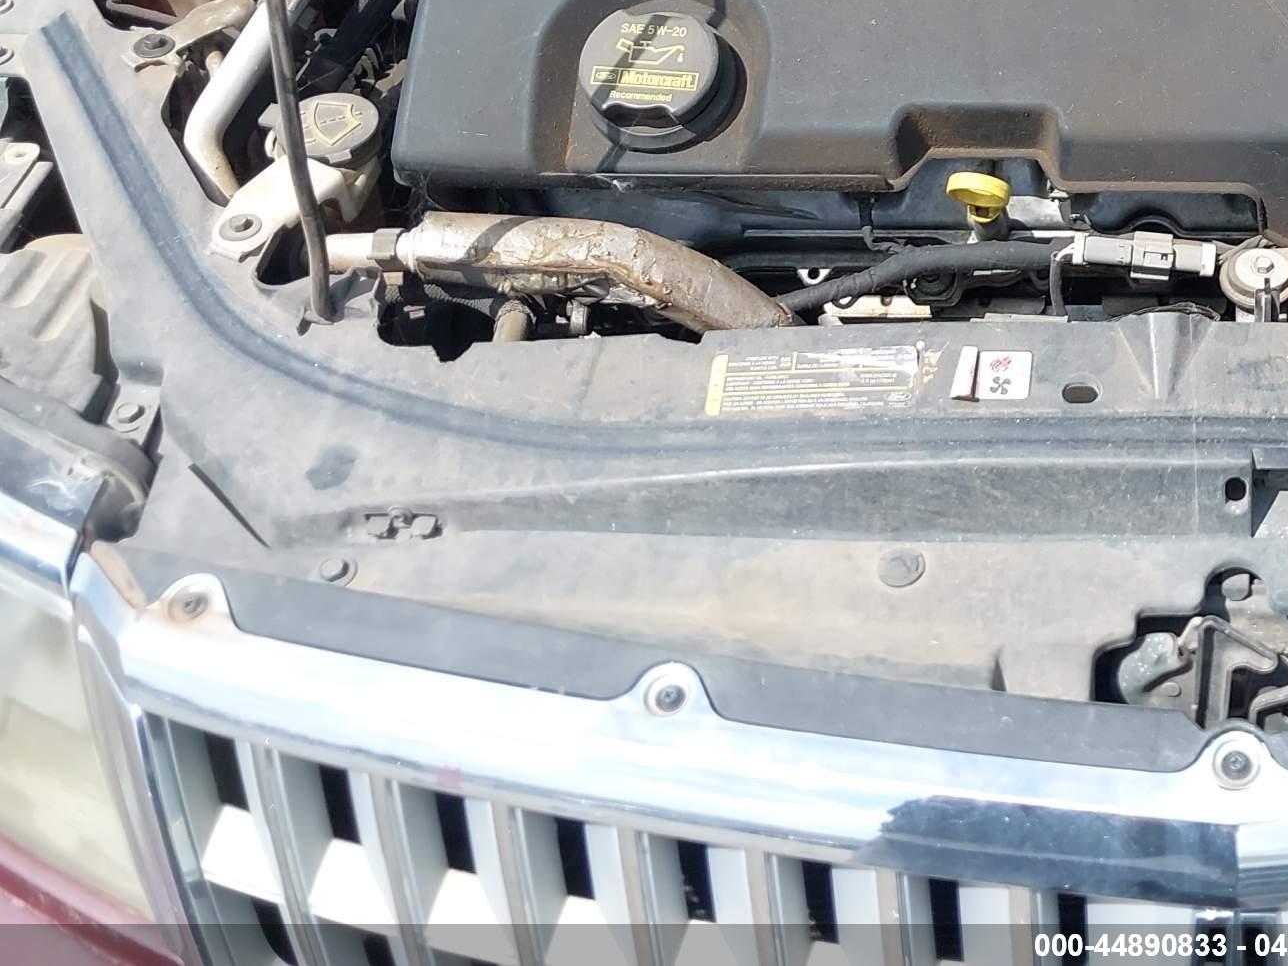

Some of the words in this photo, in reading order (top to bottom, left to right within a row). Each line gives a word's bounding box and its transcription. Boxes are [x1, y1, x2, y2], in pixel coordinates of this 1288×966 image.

[621, 23, 644, 35] SAE
[648, 24, 688, 38] 5W-20
[620, 70, 694, 89] Motorcraft
[609, 90, 673, 103] Recommended
